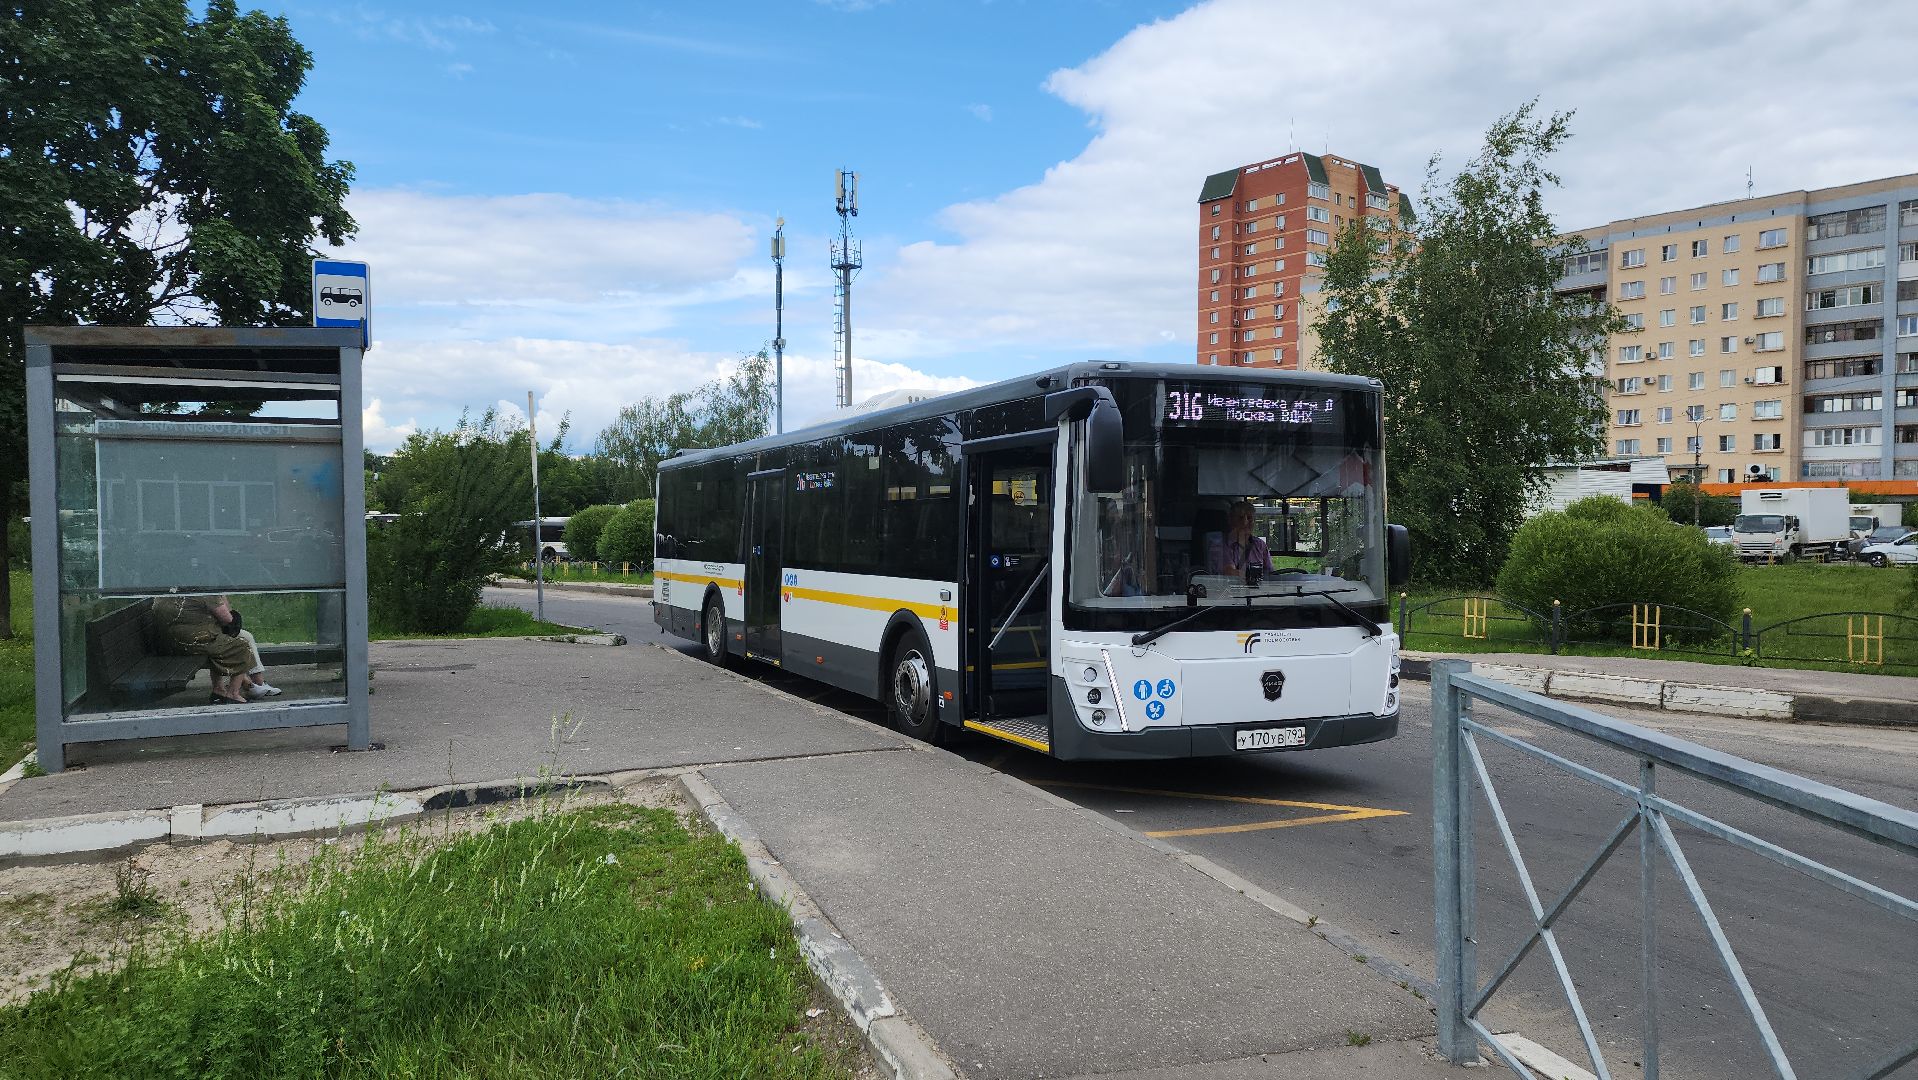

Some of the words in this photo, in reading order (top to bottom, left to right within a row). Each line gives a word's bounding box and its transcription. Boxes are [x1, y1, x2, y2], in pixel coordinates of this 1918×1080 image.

[1169, 391, 1203, 420] 316
[1226, 407, 1275, 422] Москва
[1281, 409, 1313, 424] ВДНХ
